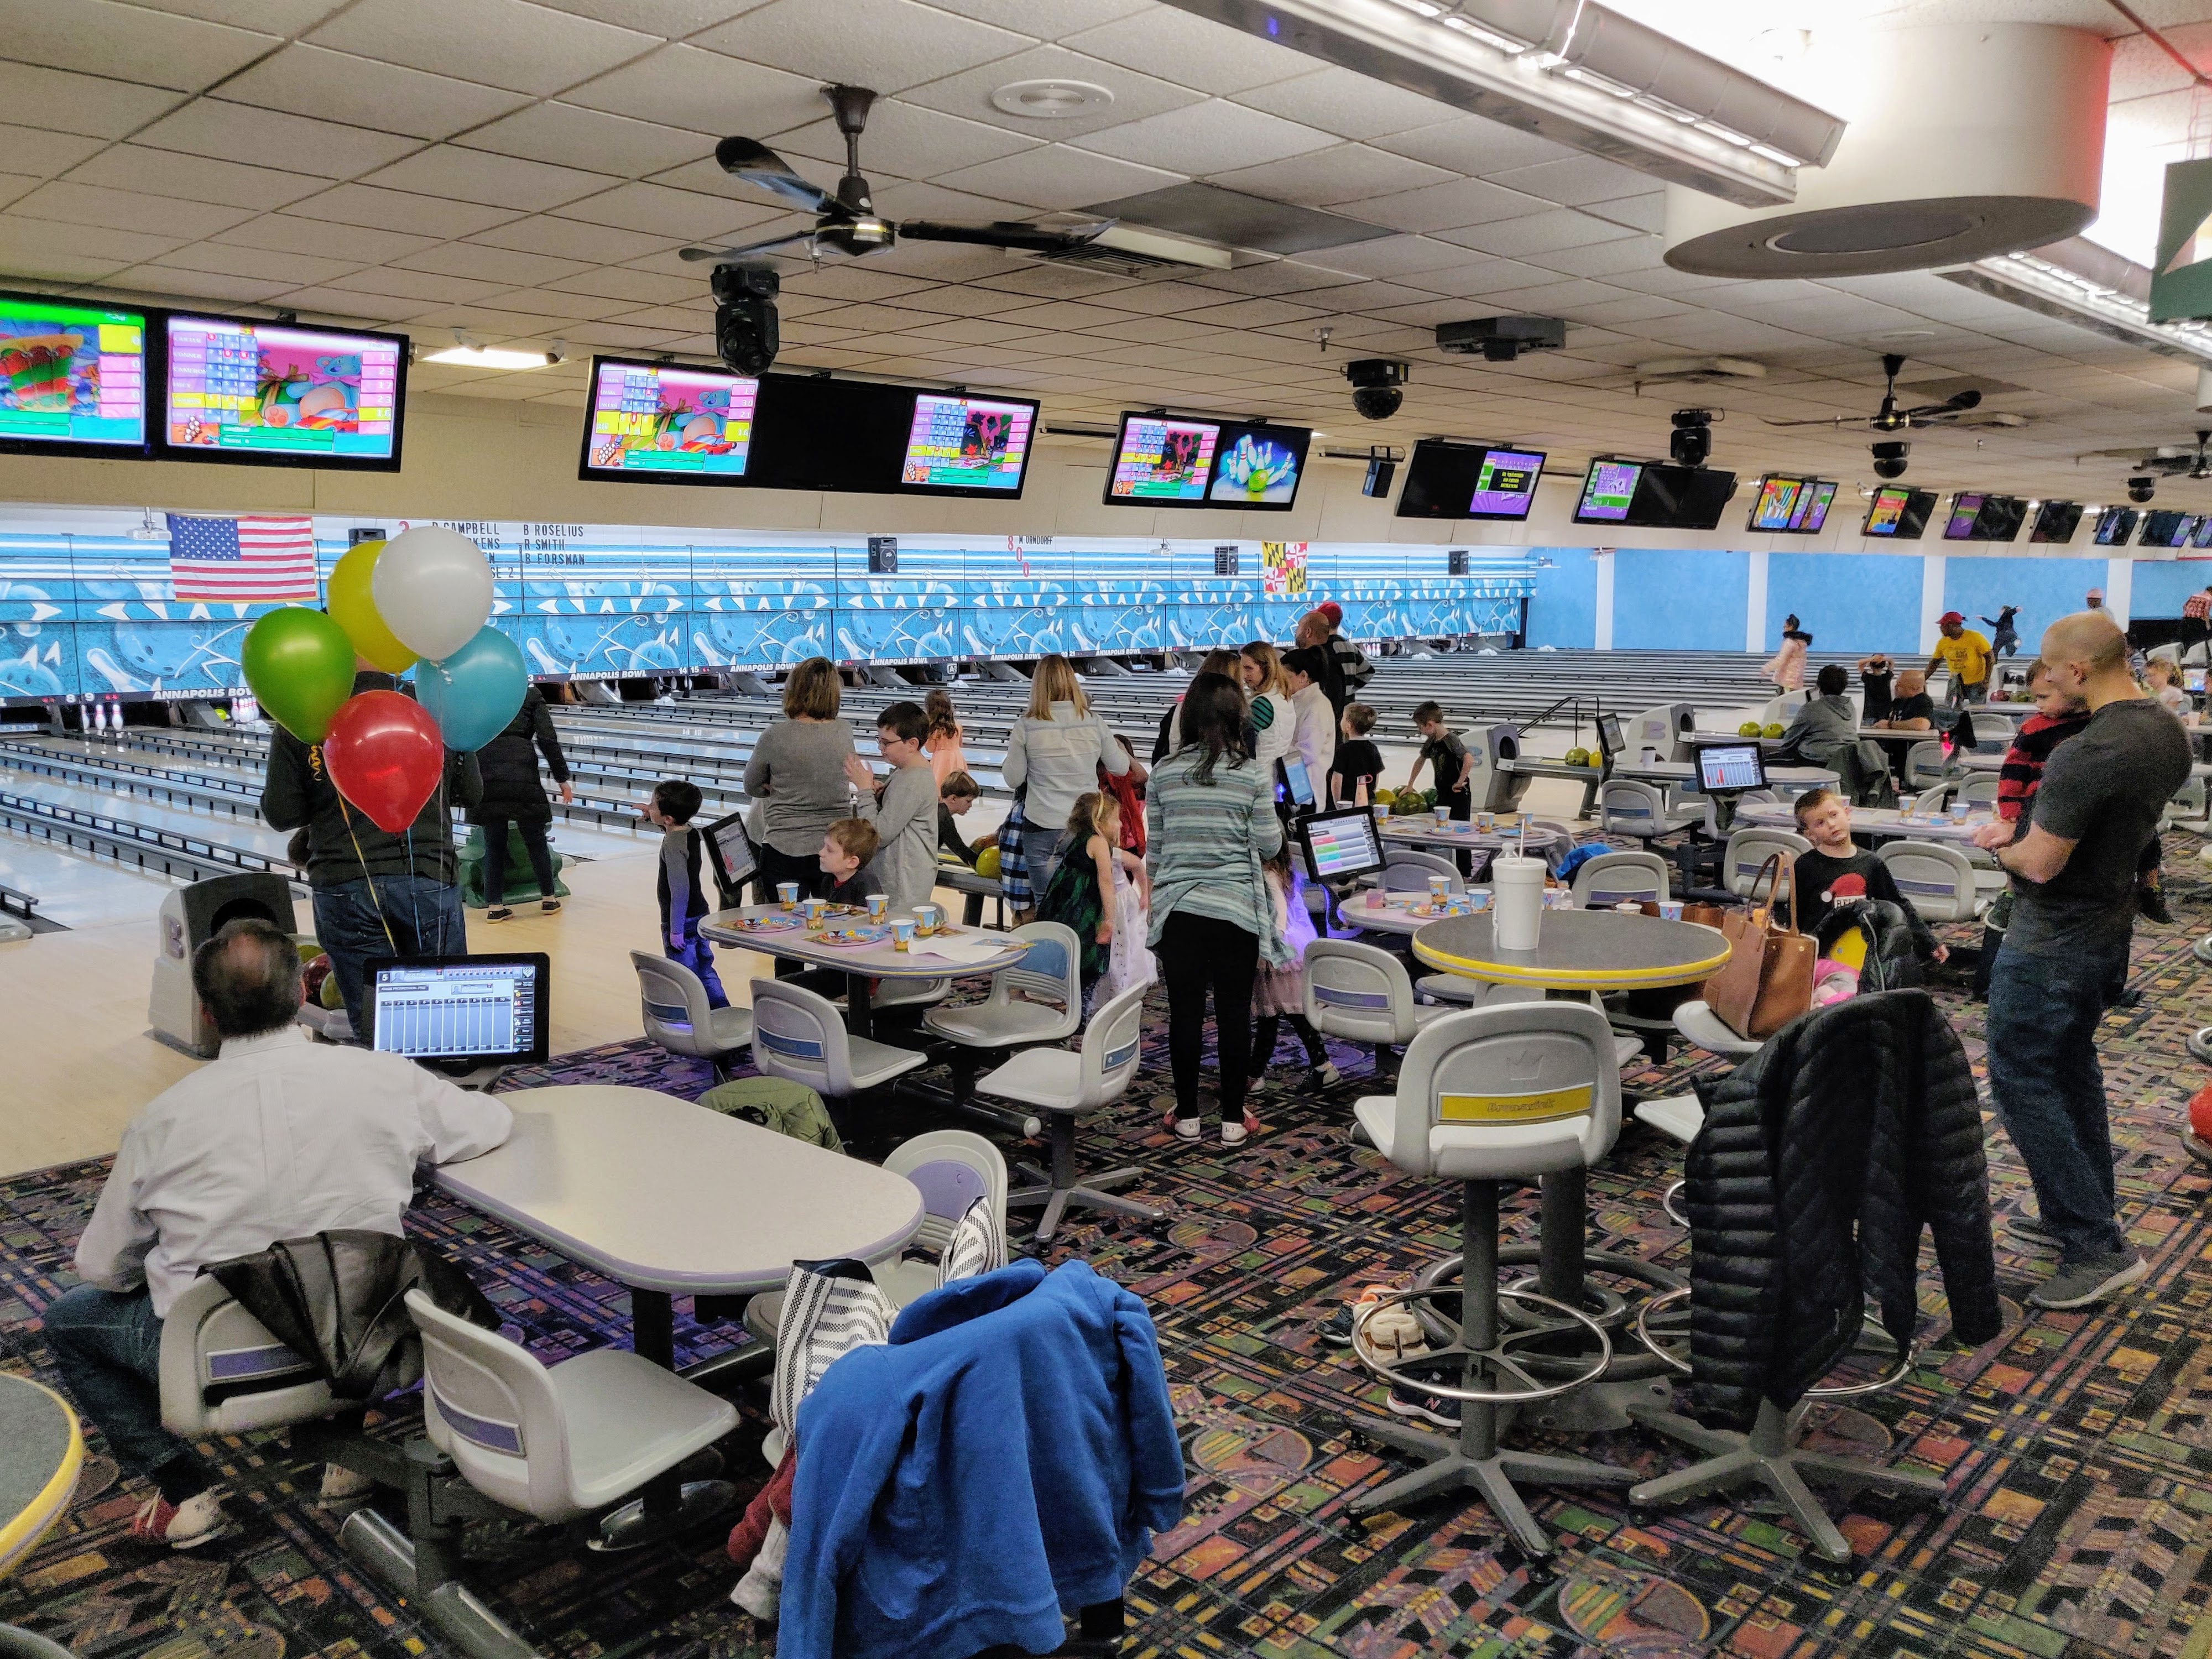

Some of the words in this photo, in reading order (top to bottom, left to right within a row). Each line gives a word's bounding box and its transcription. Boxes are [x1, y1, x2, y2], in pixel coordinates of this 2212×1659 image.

[377, 395, 392, 404] 23
[524, 524, 529, 535] B
[535, 525, 583, 536] ROSELIUS
[525, 539, 531, 550] R
[536, 539, 565, 550] SMITH
[1019, 535, 1023, 544] M
[1026, 535, 1053, 545] ORNDORFF
[526, 553, 531, 564] B
[538, 554, 585, 565] FORSMAN
[509, 567, 514, 578] 2
[869, 657, 908, 665] ANNAPOLIS
[730, 664, 774, 672] ANNAPOLIS
[570, 671, 620, 681] ANNAPOLIS
[622, 670, 647, 679] BOWL
[66, 693, 76, 703] 8
[85, 692, 95, 701] 9
[152, 688, 225, 700] ANNAPOLIS
[228, 687, 253, 697] BOW
